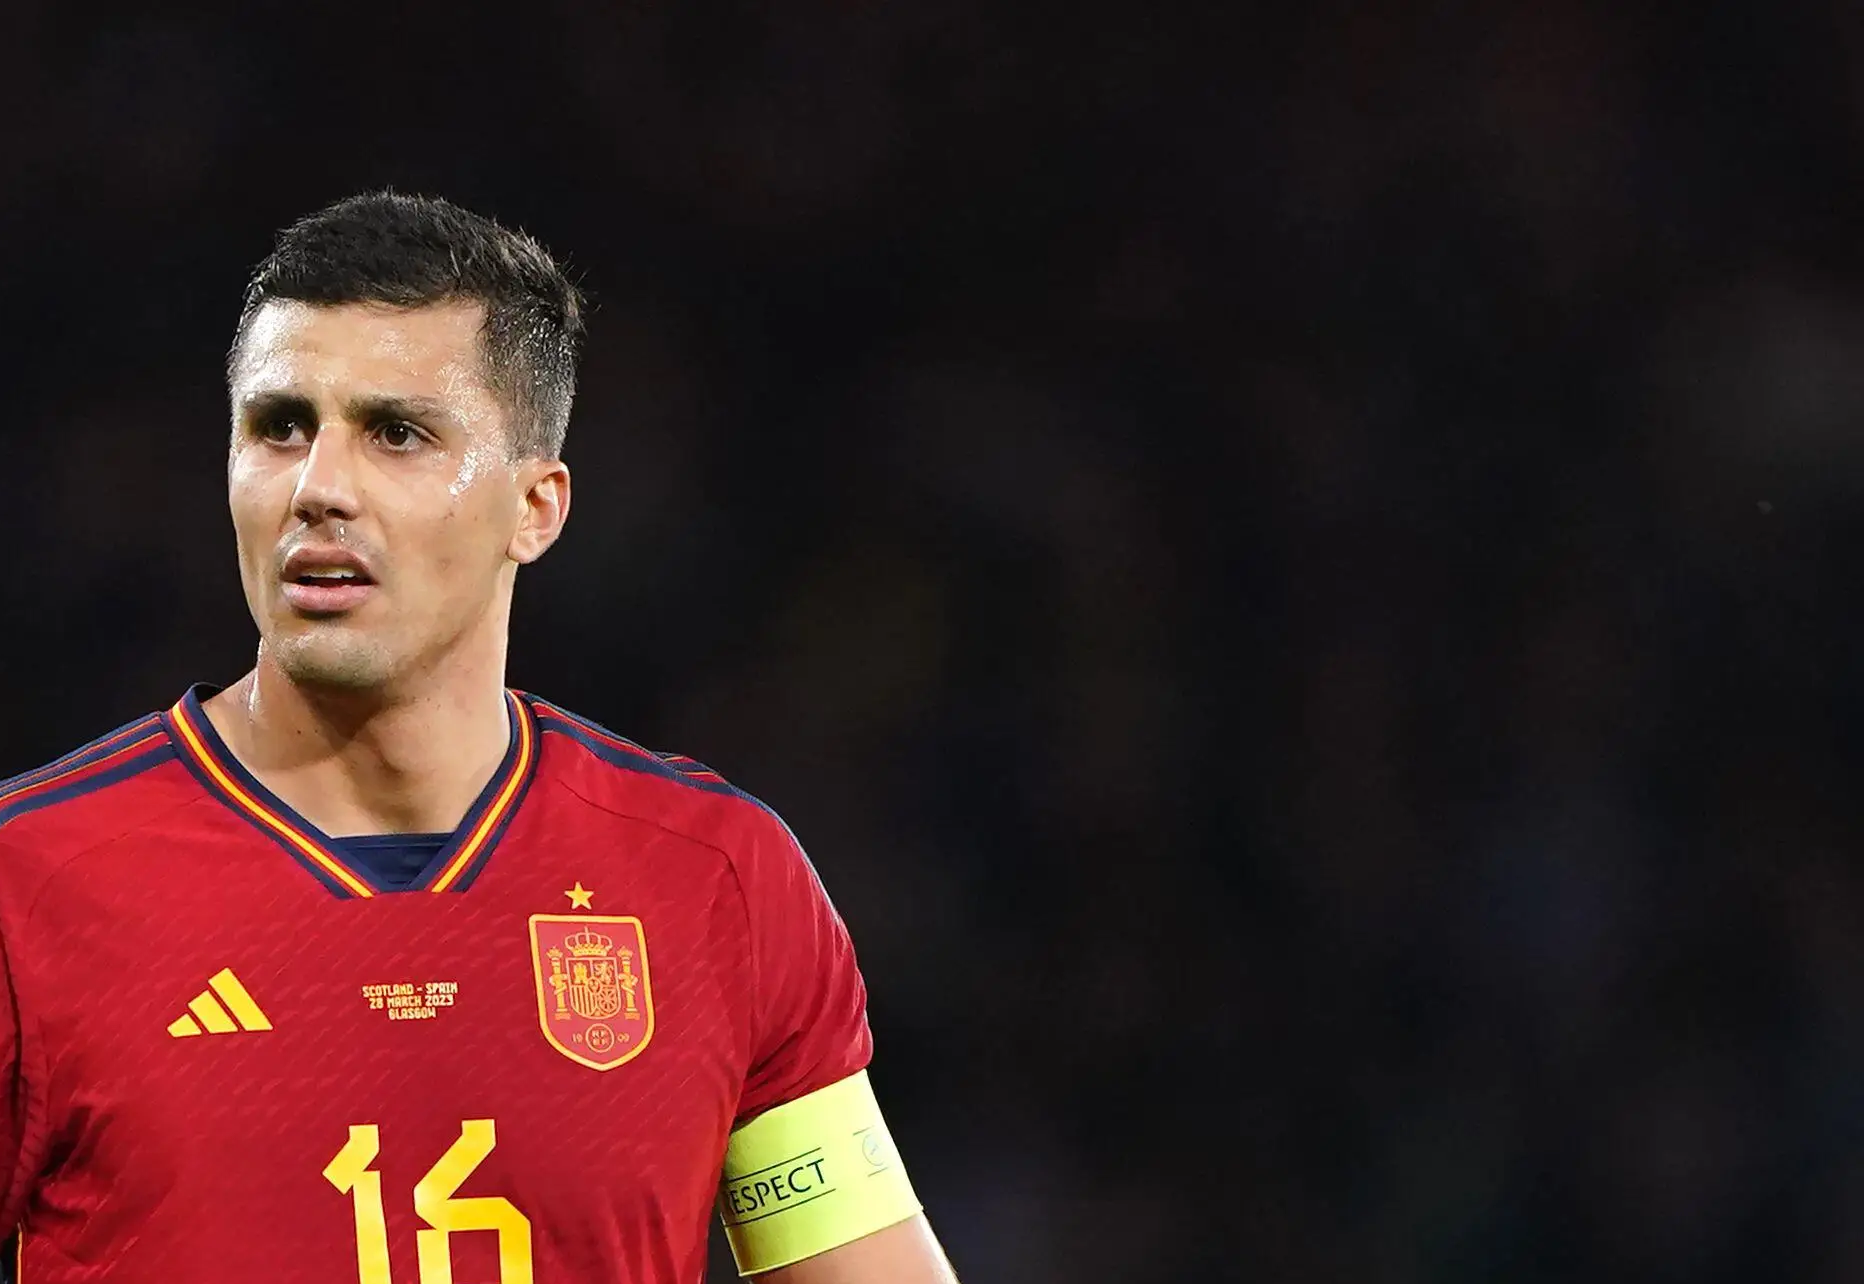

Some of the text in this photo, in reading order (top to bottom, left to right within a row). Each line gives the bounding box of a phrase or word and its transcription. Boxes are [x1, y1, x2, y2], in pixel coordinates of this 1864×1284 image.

[362, 983, 414, 998] SCOTLAND
[425, 982, 458, 994] SPAIN
[369, 994, 454, 1009] 28 MARCH 2023
[388, 1006, 436, 1020] GLASGOW
[728, 1157, 826, 1216] ESPECT
